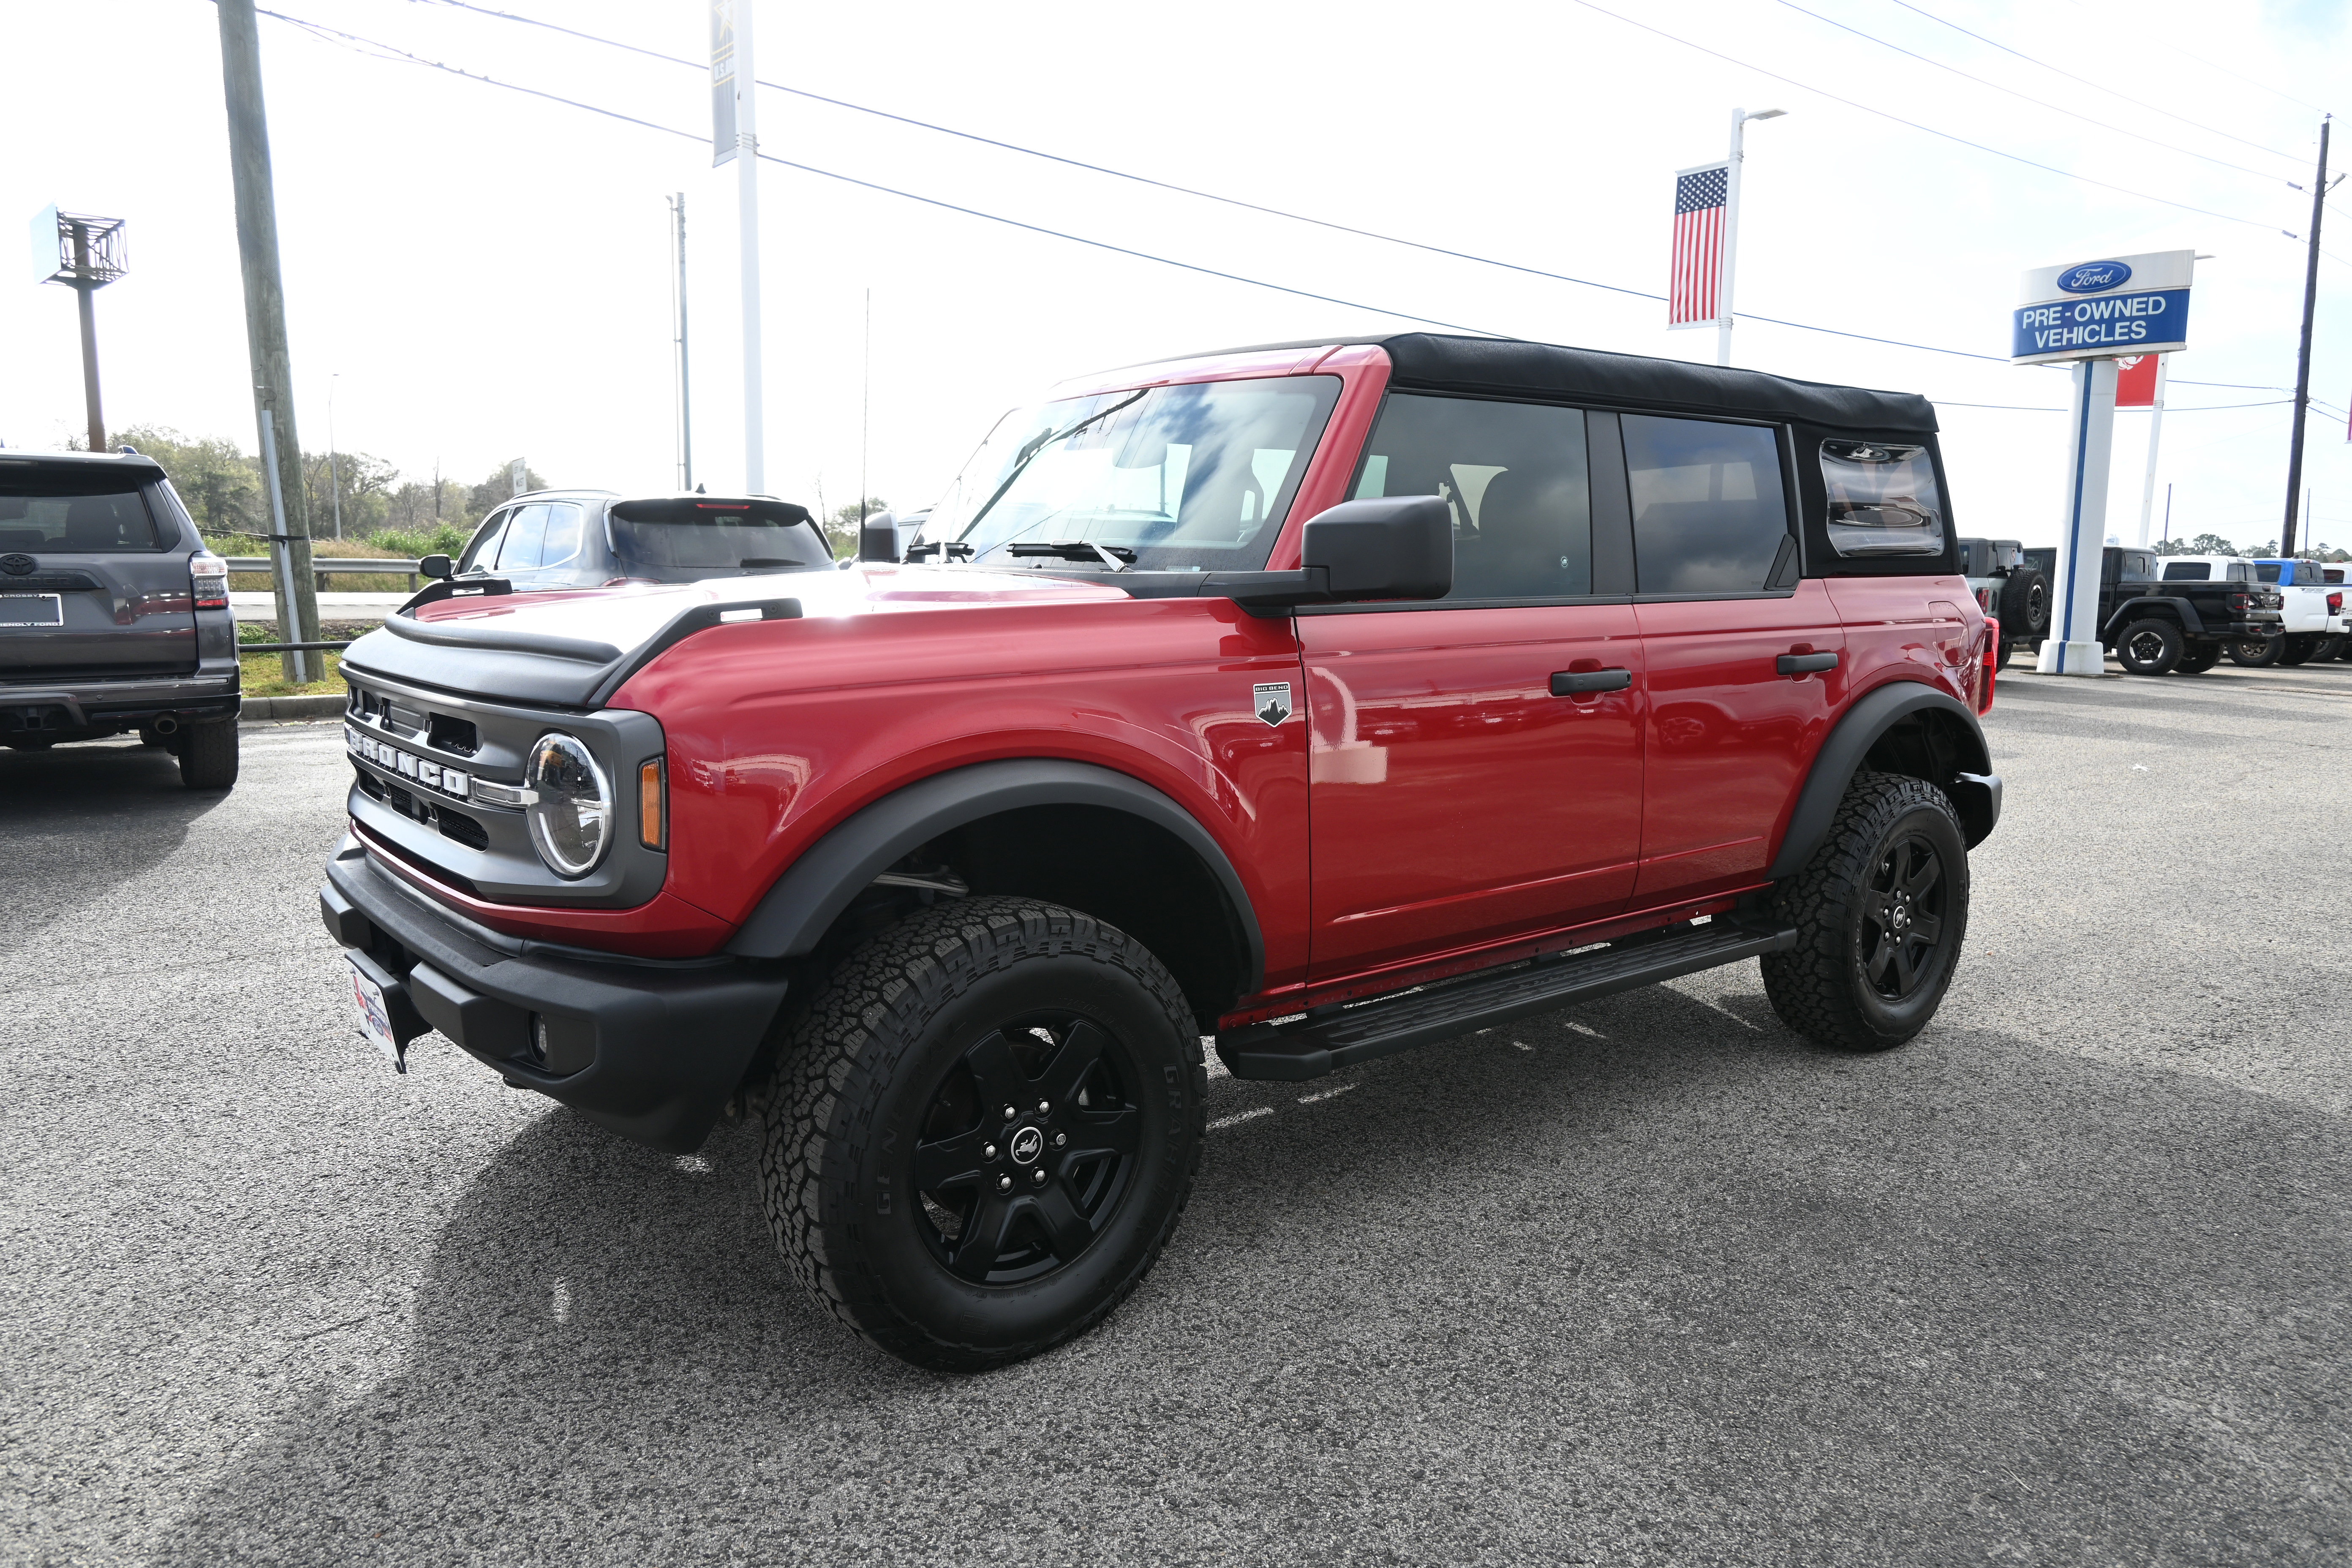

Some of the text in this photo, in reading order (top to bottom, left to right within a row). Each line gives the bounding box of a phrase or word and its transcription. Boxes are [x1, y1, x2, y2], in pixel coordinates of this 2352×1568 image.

[2071, 267, 2113, 287] Ford
[2022, 296, 2166, 329] PRE-OWNED
[2035, 320, 2147, 348] VEHICLES
[349, 728, 468, 795] BRONCO
[1936, 879, 1965, 986] GENERAL
[875, 1021, 966, 1216] GENERAL
[1135, 1063, 1183, 1244] GRABBER
